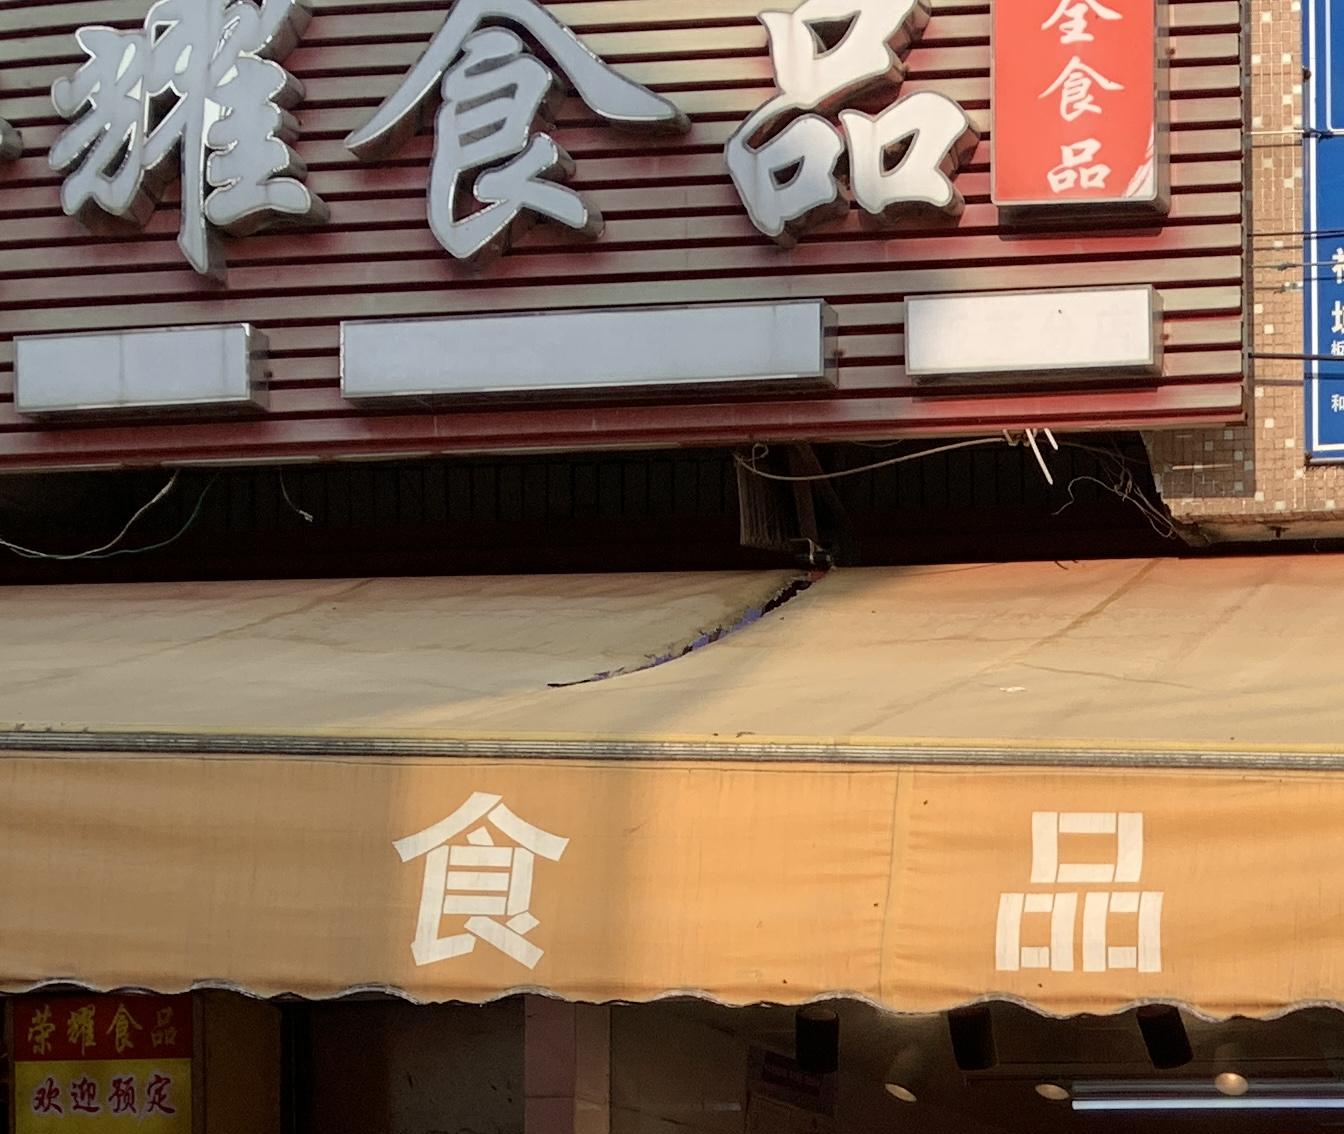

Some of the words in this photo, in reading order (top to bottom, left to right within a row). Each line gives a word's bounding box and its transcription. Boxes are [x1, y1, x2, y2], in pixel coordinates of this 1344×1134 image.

[391, 791, 571, 969] 食
[995, 811, 1167, 973] 品
[27, 1004, 178, 1056] 荣耀食品
[33, 1073, 176, 1114] 欢迎预定
